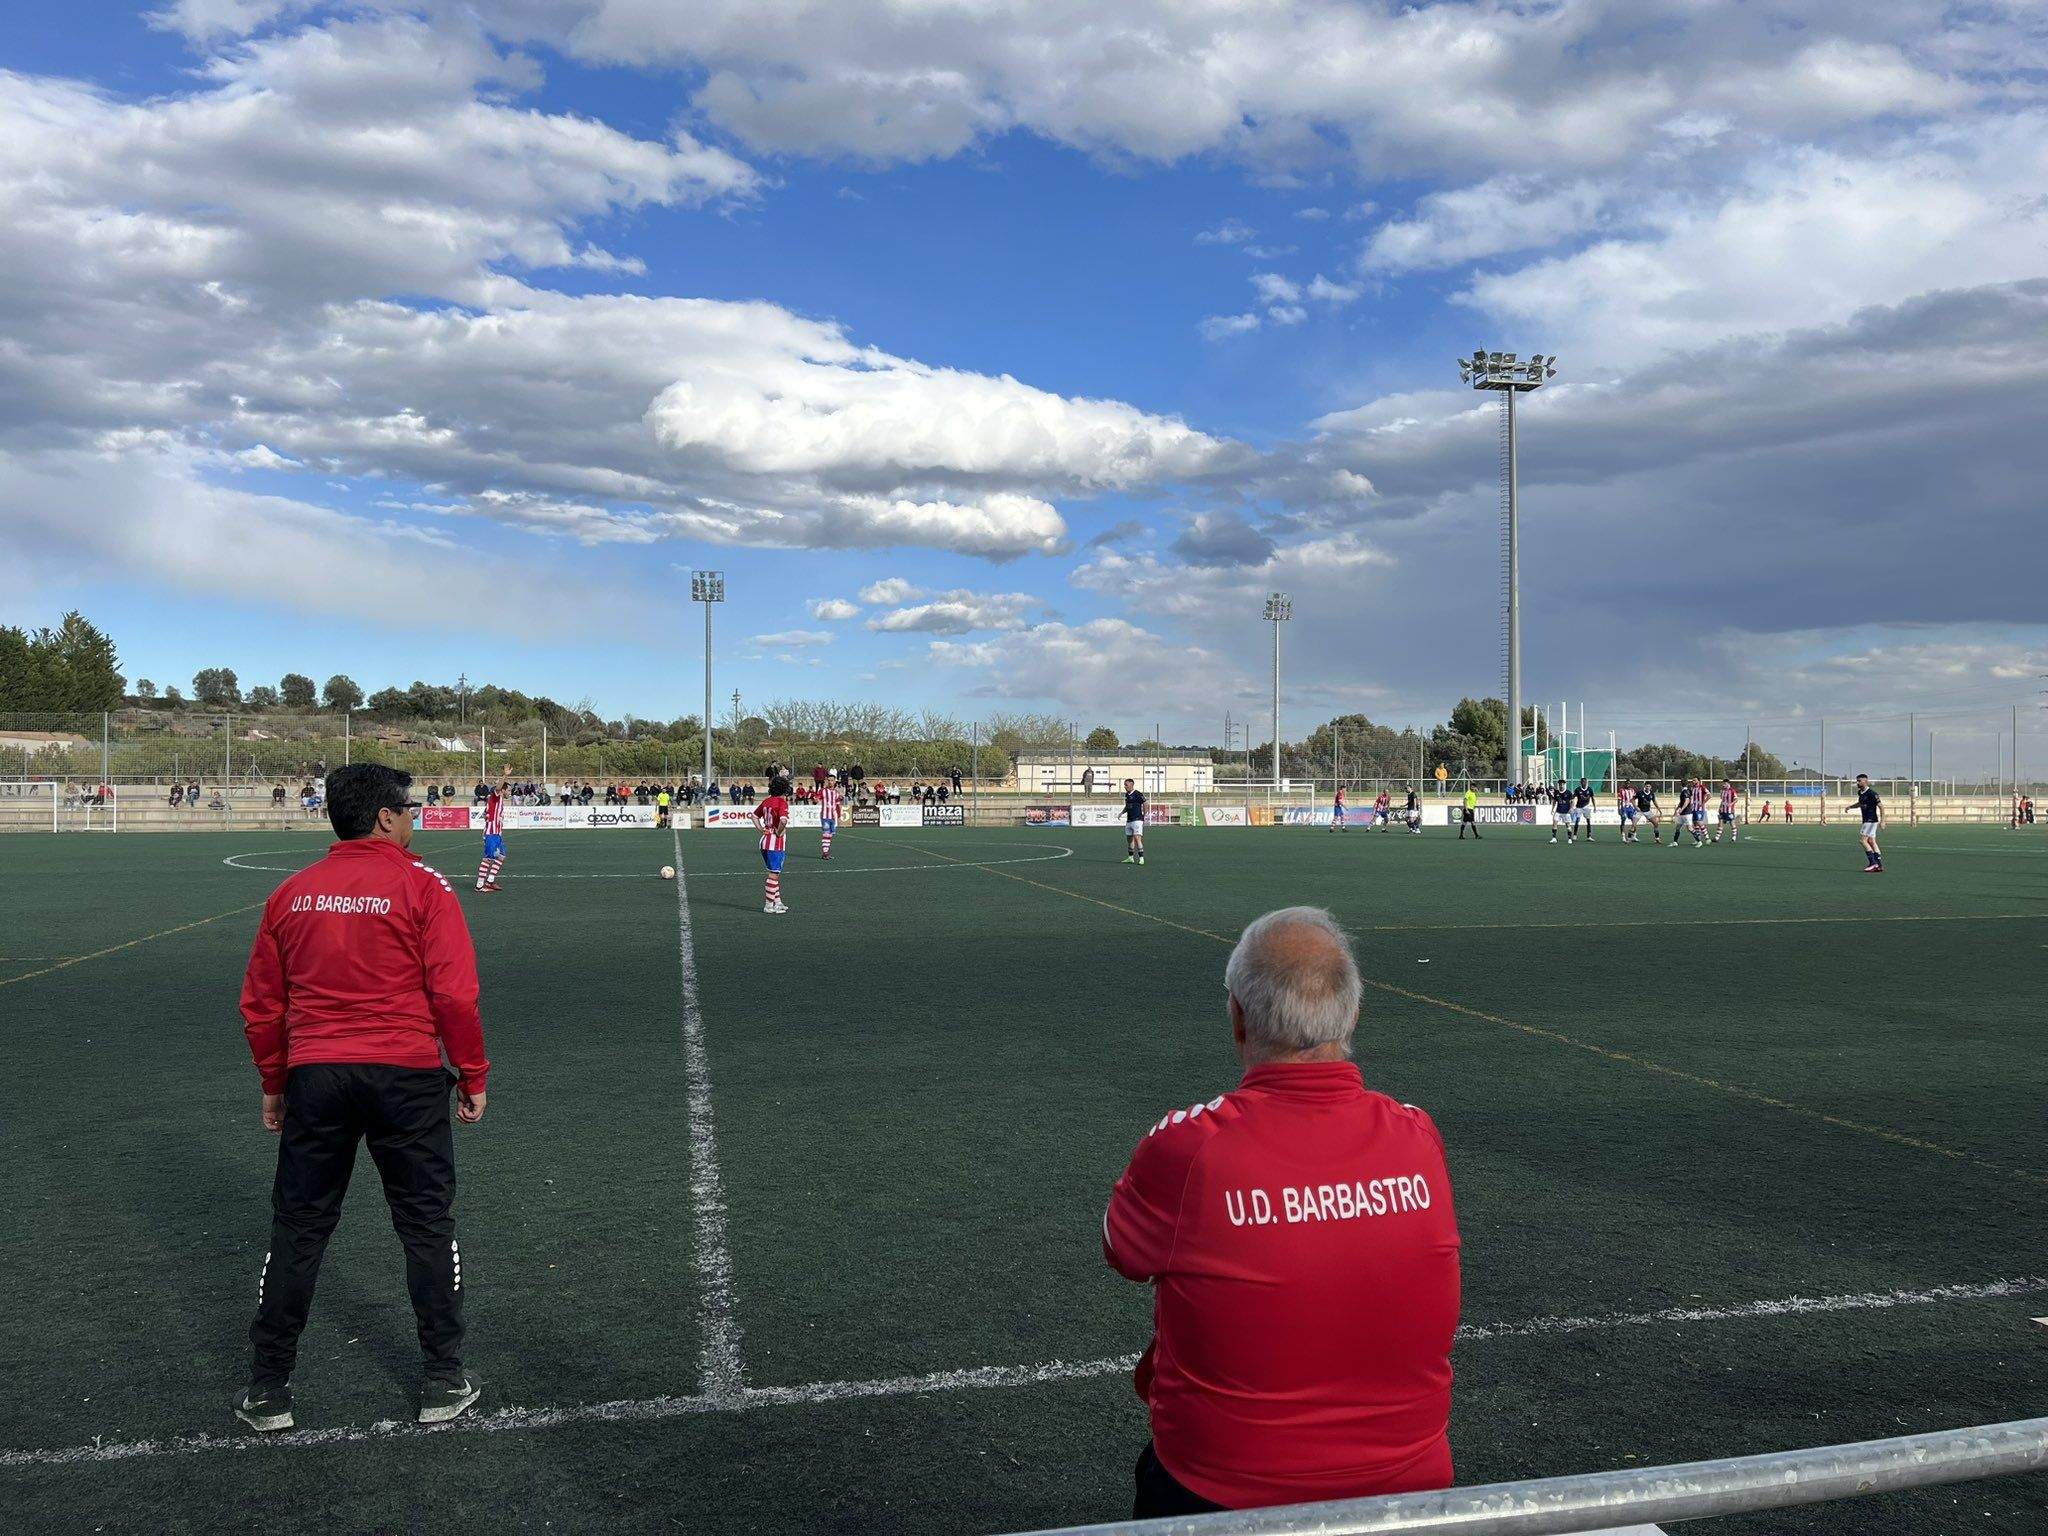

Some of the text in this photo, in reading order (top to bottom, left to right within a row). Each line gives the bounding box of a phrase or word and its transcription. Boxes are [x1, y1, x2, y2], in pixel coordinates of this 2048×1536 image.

[924, 806, 962, 816] maza
[292, 894, 391, 915] U.D. BARBASTRO
[1225, 1174, 1431, 1226] U.D. BARBASTRO
